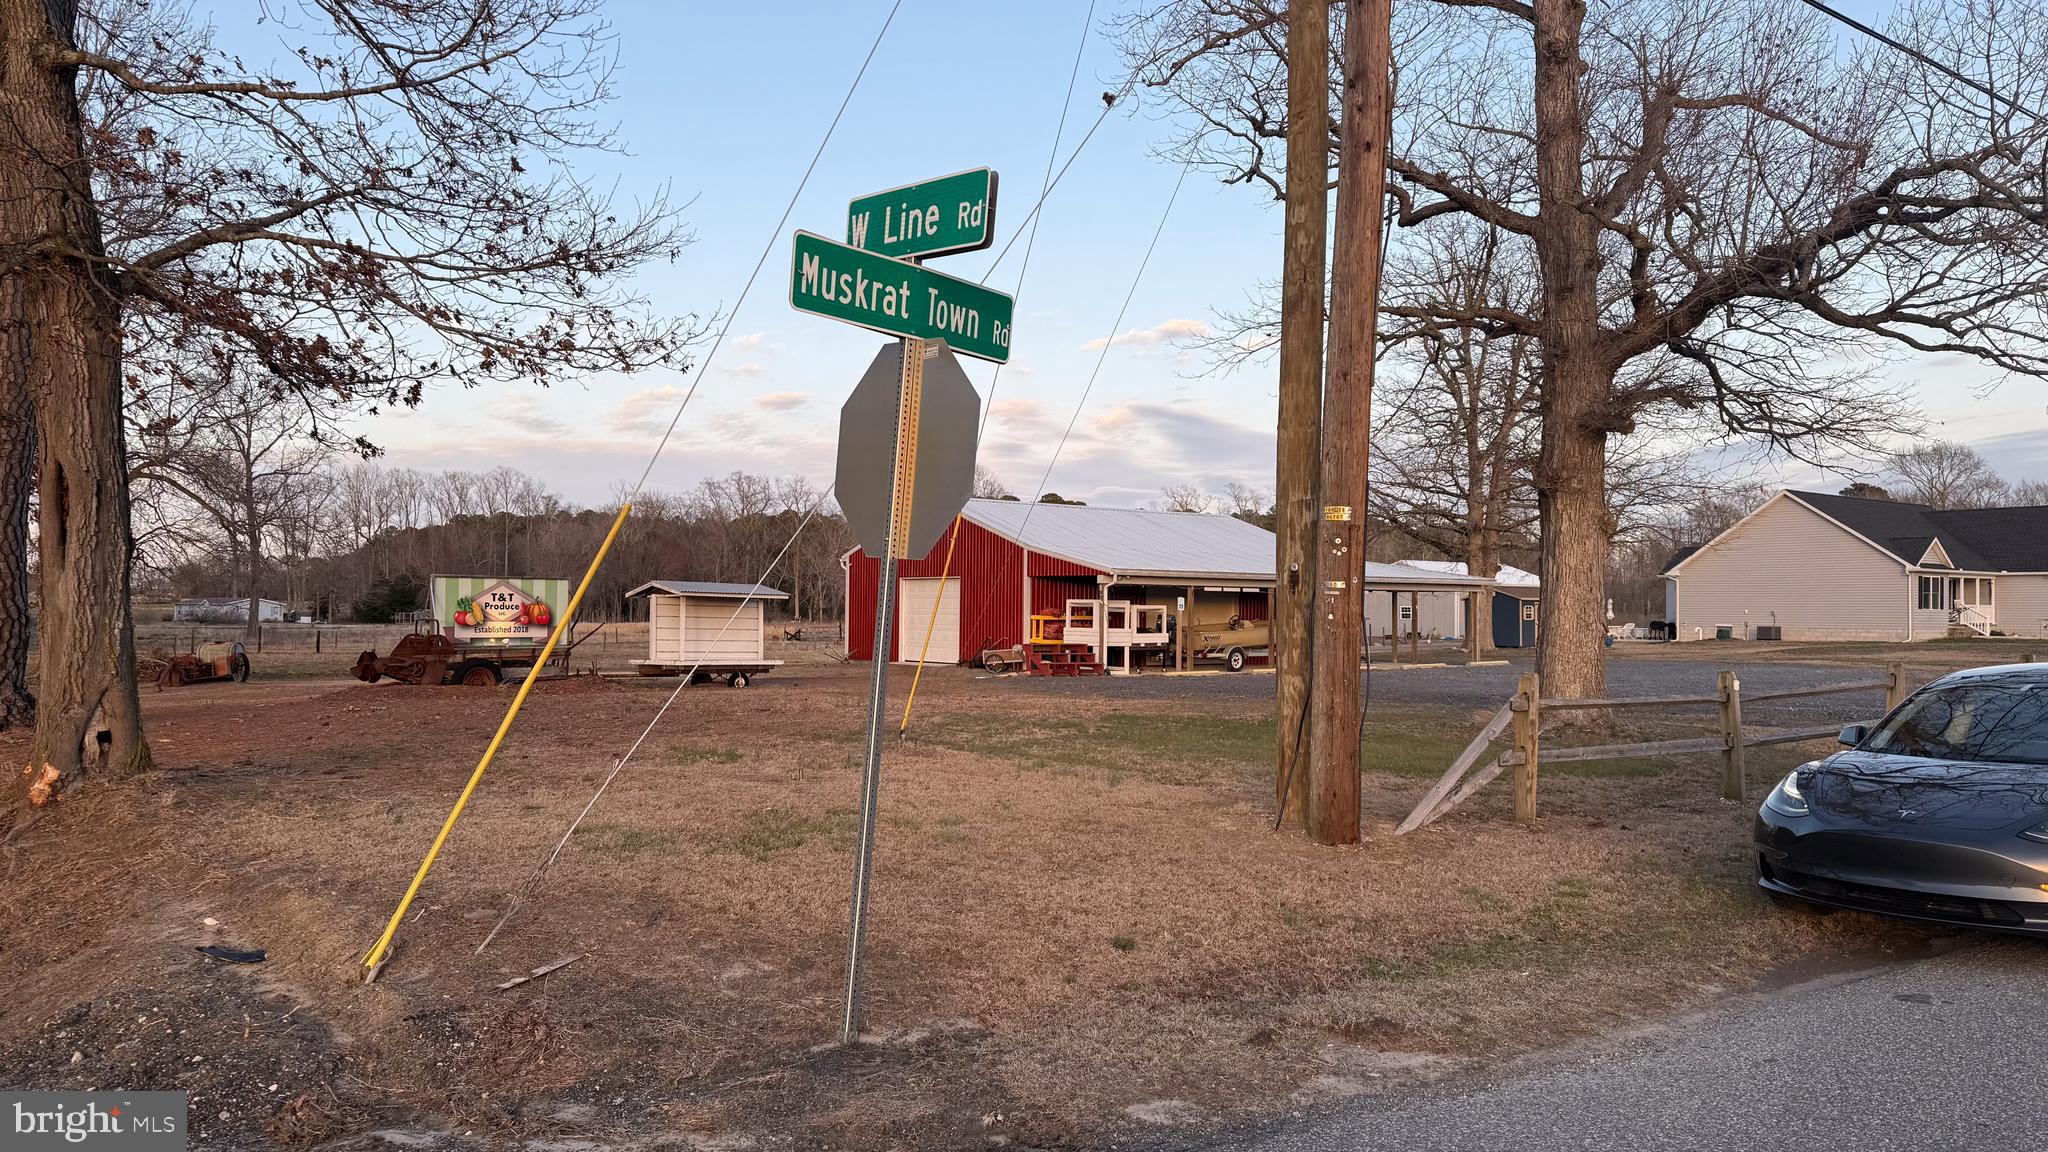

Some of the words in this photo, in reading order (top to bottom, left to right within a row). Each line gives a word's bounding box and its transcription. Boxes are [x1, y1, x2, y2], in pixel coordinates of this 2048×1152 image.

[851, 211, 870, 249] W
[883, 202, 940, 245] Line
[957, 199, 983, 230] Rd
[801, 252, 911, 320] Muskrat
[928, 287, 980, 340] Town
[992, 319, 1010, 348] Rd
[484, 602, 520, 610] Produce
[491, 593, 514, 602] T&T
